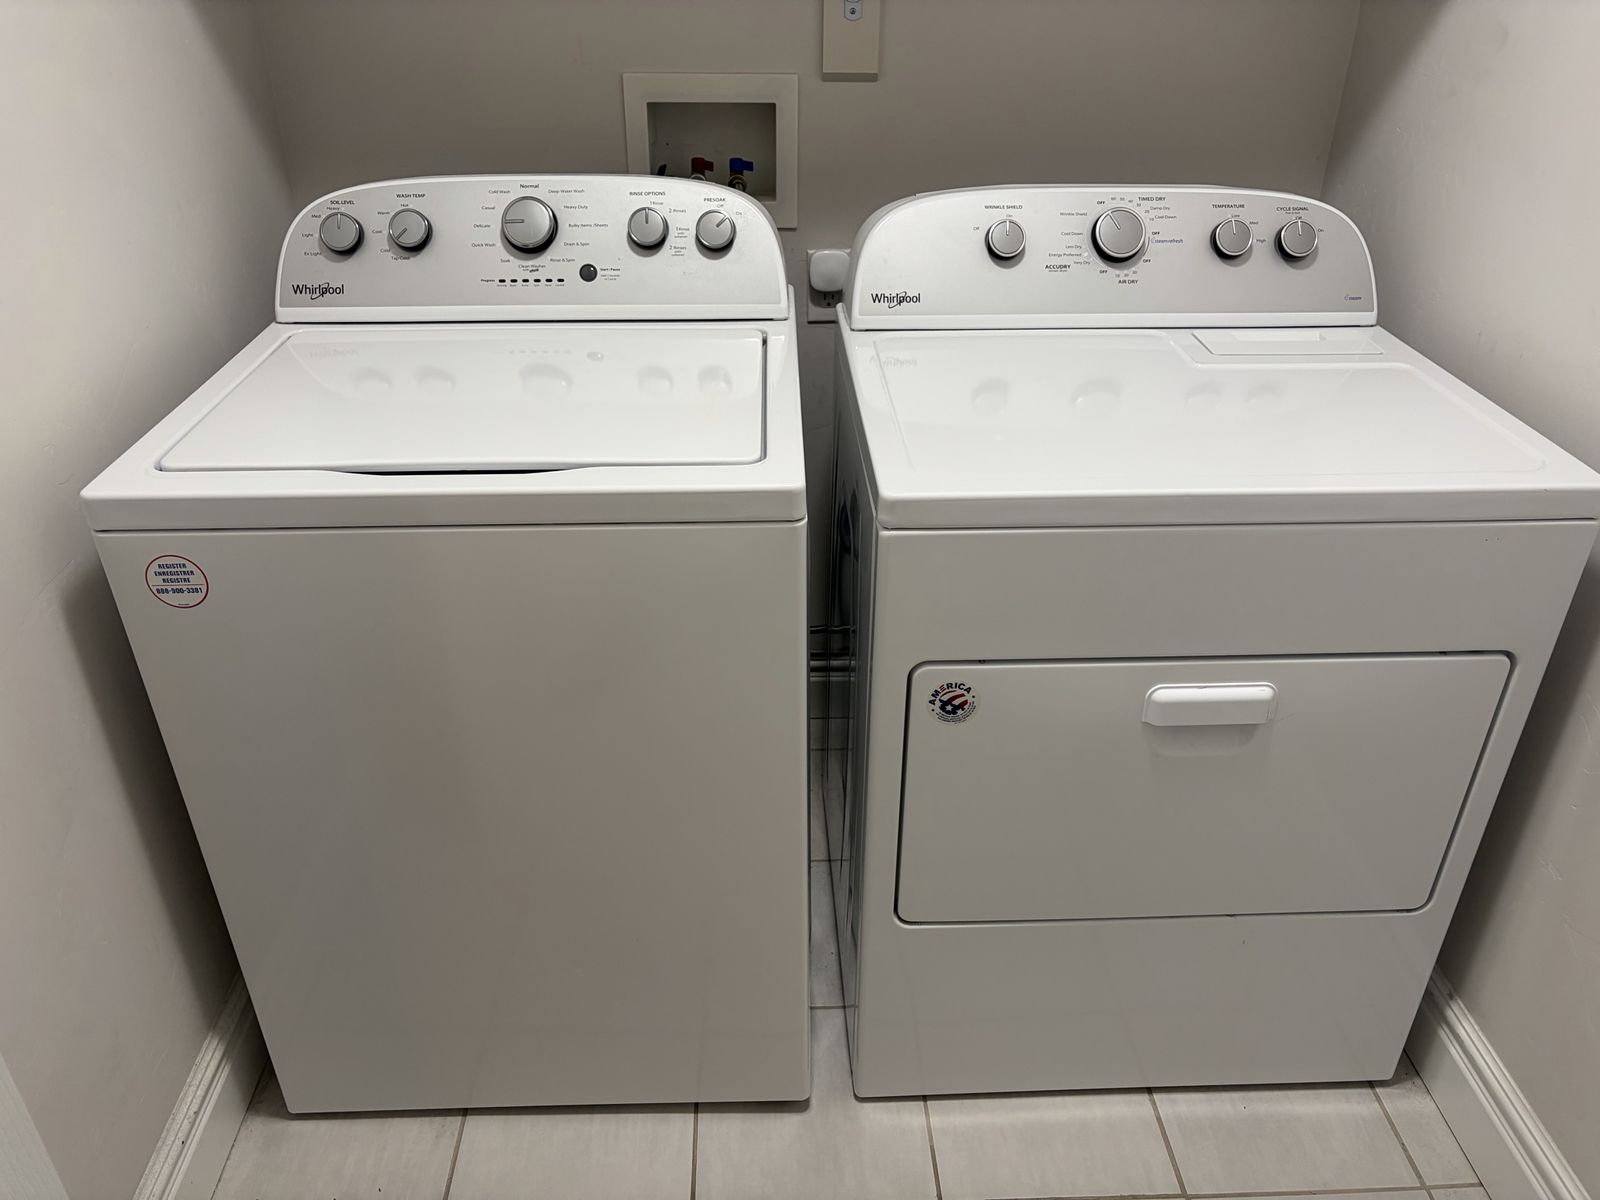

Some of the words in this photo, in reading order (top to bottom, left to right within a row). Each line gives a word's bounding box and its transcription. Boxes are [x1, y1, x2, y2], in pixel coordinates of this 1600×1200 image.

[291, 281, 345, 300] Whirlpool
[870, 291, 921, 309] Whirlpool
[928, 682, 972, 706] AMERICA
